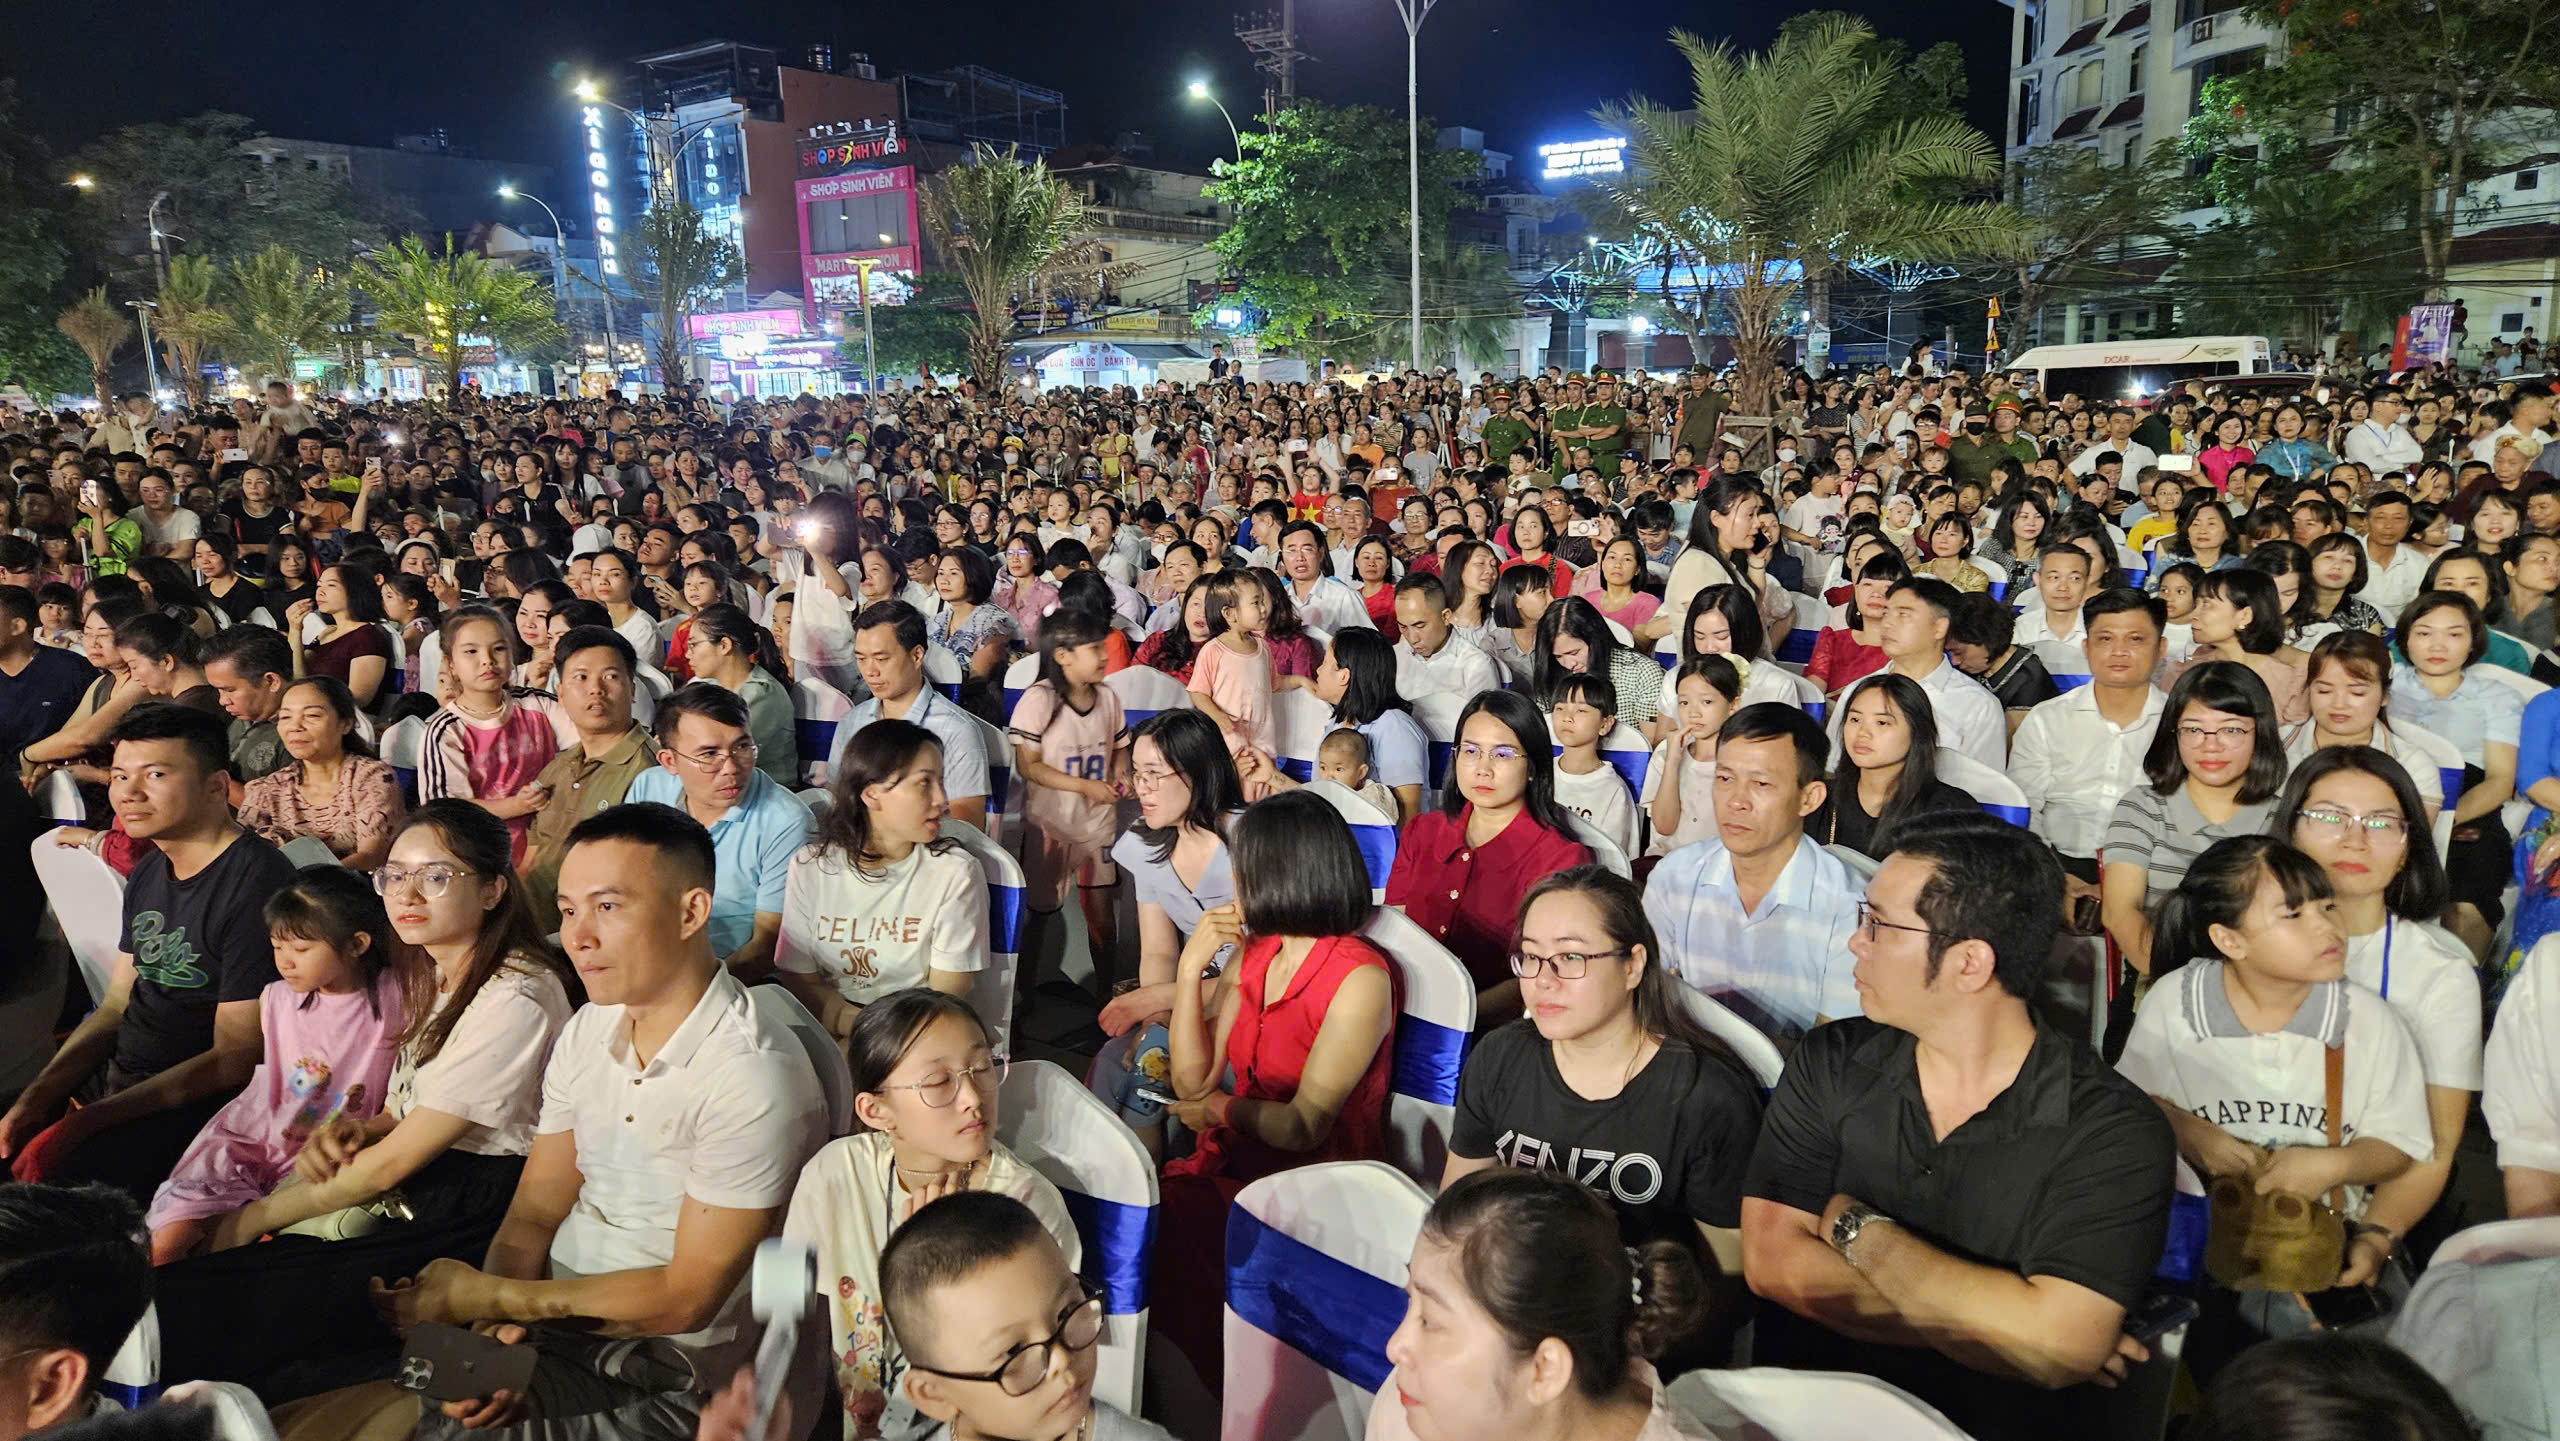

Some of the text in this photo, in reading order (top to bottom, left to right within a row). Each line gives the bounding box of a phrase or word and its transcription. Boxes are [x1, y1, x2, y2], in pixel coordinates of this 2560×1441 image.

[802, 148, 835, 167] SHOP
[809, 180, 840, 197] SHOP
[841, 178, 867, 194] SINH
[815, 257, 846, 273] MART
[2104, 355, 2130, 363] DCAR
[817, 916, 922, 943] CELINE
[132, 910, 202, 974] Polo
[1495, 1130, 1663, 1205] KENZO
